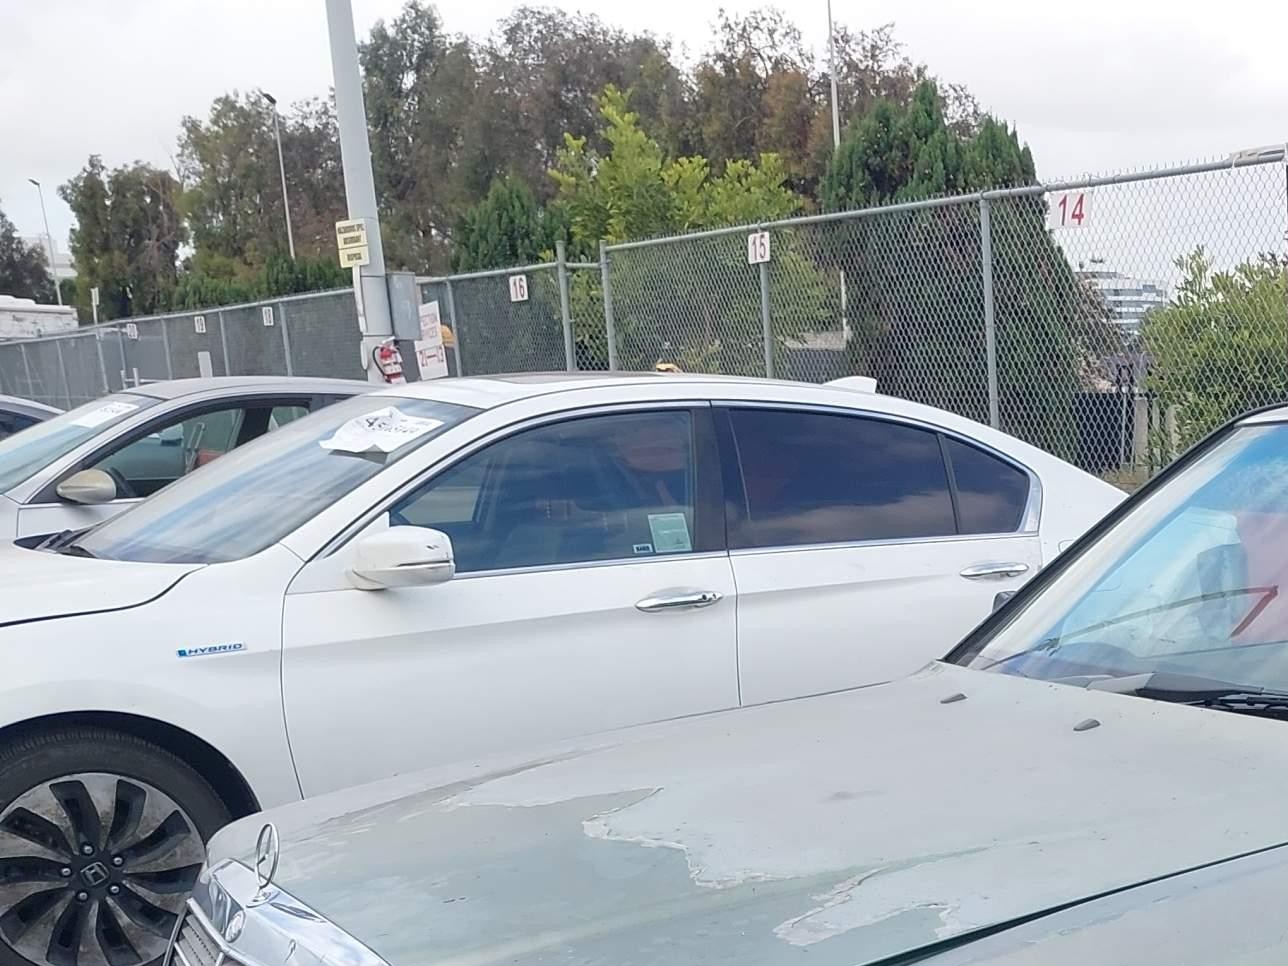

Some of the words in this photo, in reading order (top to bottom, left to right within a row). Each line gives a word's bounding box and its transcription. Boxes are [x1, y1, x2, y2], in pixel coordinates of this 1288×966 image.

[1058, 193, 1085, 226] 14
[752, 233, 766, 261] 15
[512, 276, 525, 299] 16
[188, 643, 242, 655] HYBRID
